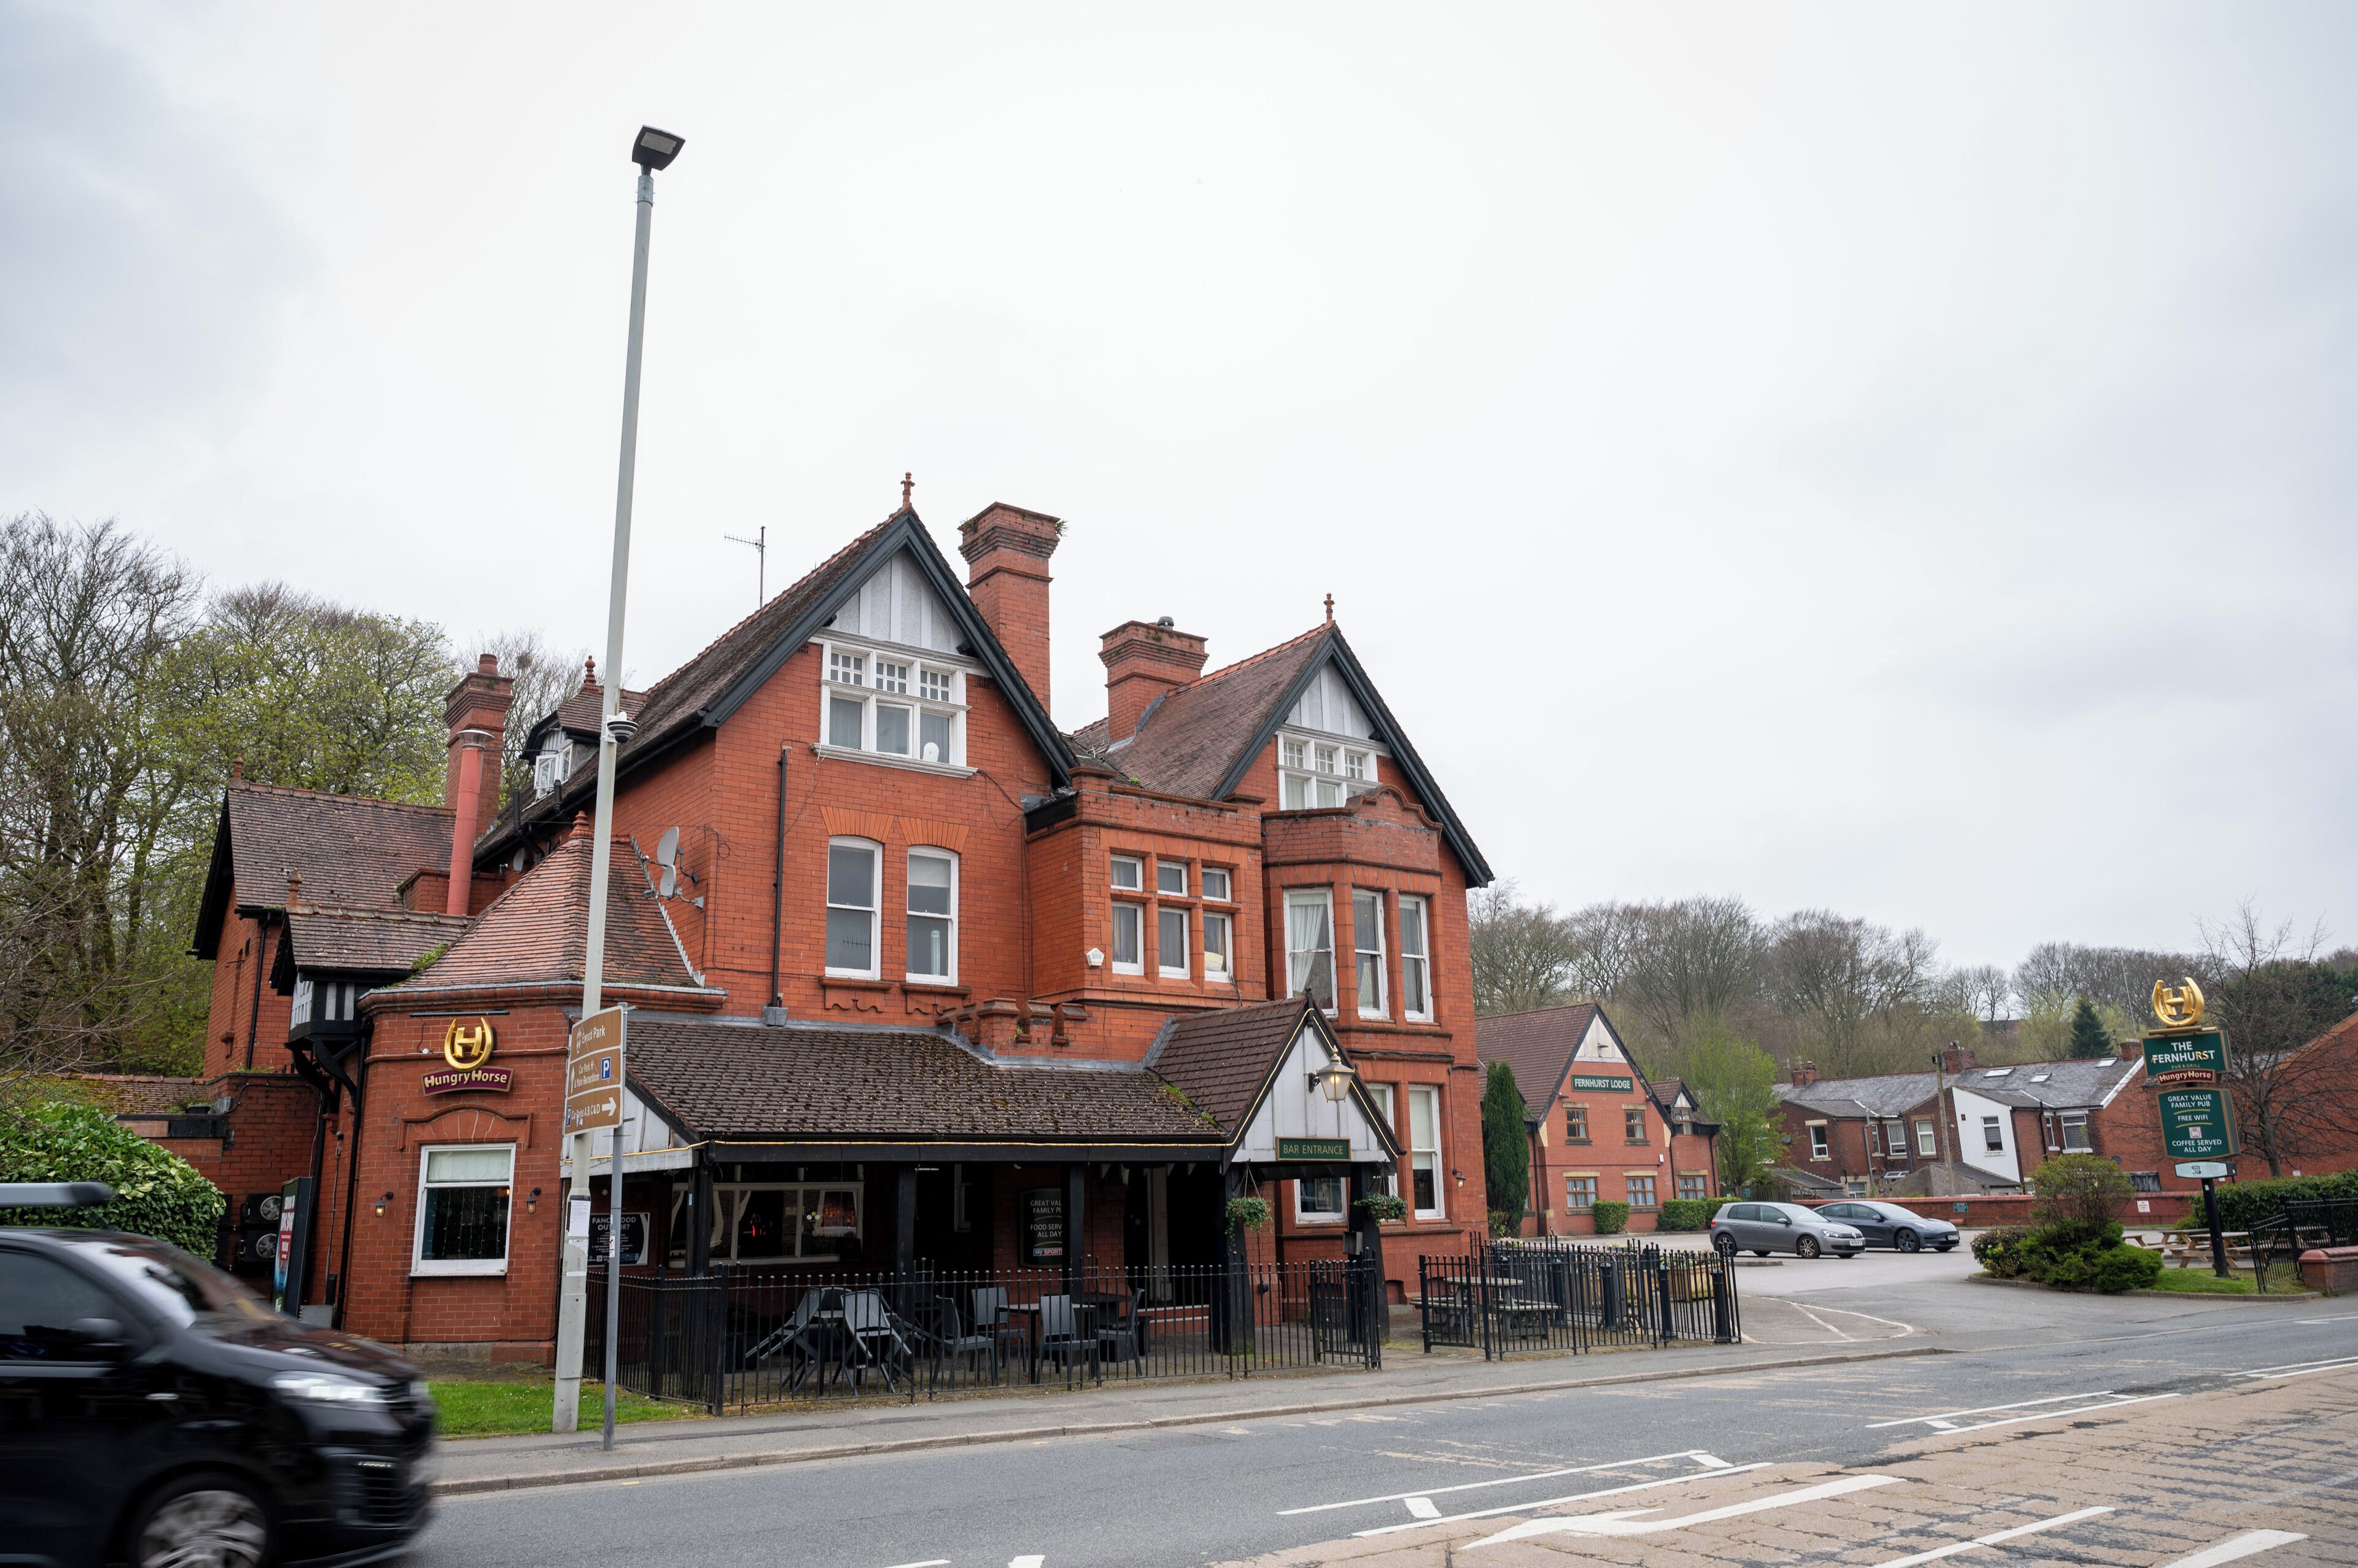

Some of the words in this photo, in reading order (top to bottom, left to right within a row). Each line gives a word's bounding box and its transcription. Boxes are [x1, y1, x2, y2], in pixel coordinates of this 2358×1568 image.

[593, 1025, 605, 1039] Park
[2171, 1041, 2193, 1052] THE
[2152, 1050, 2215, 1063] FERNHURST
[603, 1060, 609, 1078] P
[424, 1073, 470, 1088] Hungry
[471, 1070, 507, 1083] Horse
[583, 1072, 599, 1085] Reception
[1574, 1078, 1609, 1088] FERNHURST
[1611, 1079, 1630, 1089] LODGE
[2159, 1073, 2187, 1082] Hungry
[1283, 1144, 1299, 1154] BAR
[1302, 1145, 1344, 1154] ENTRANCE
